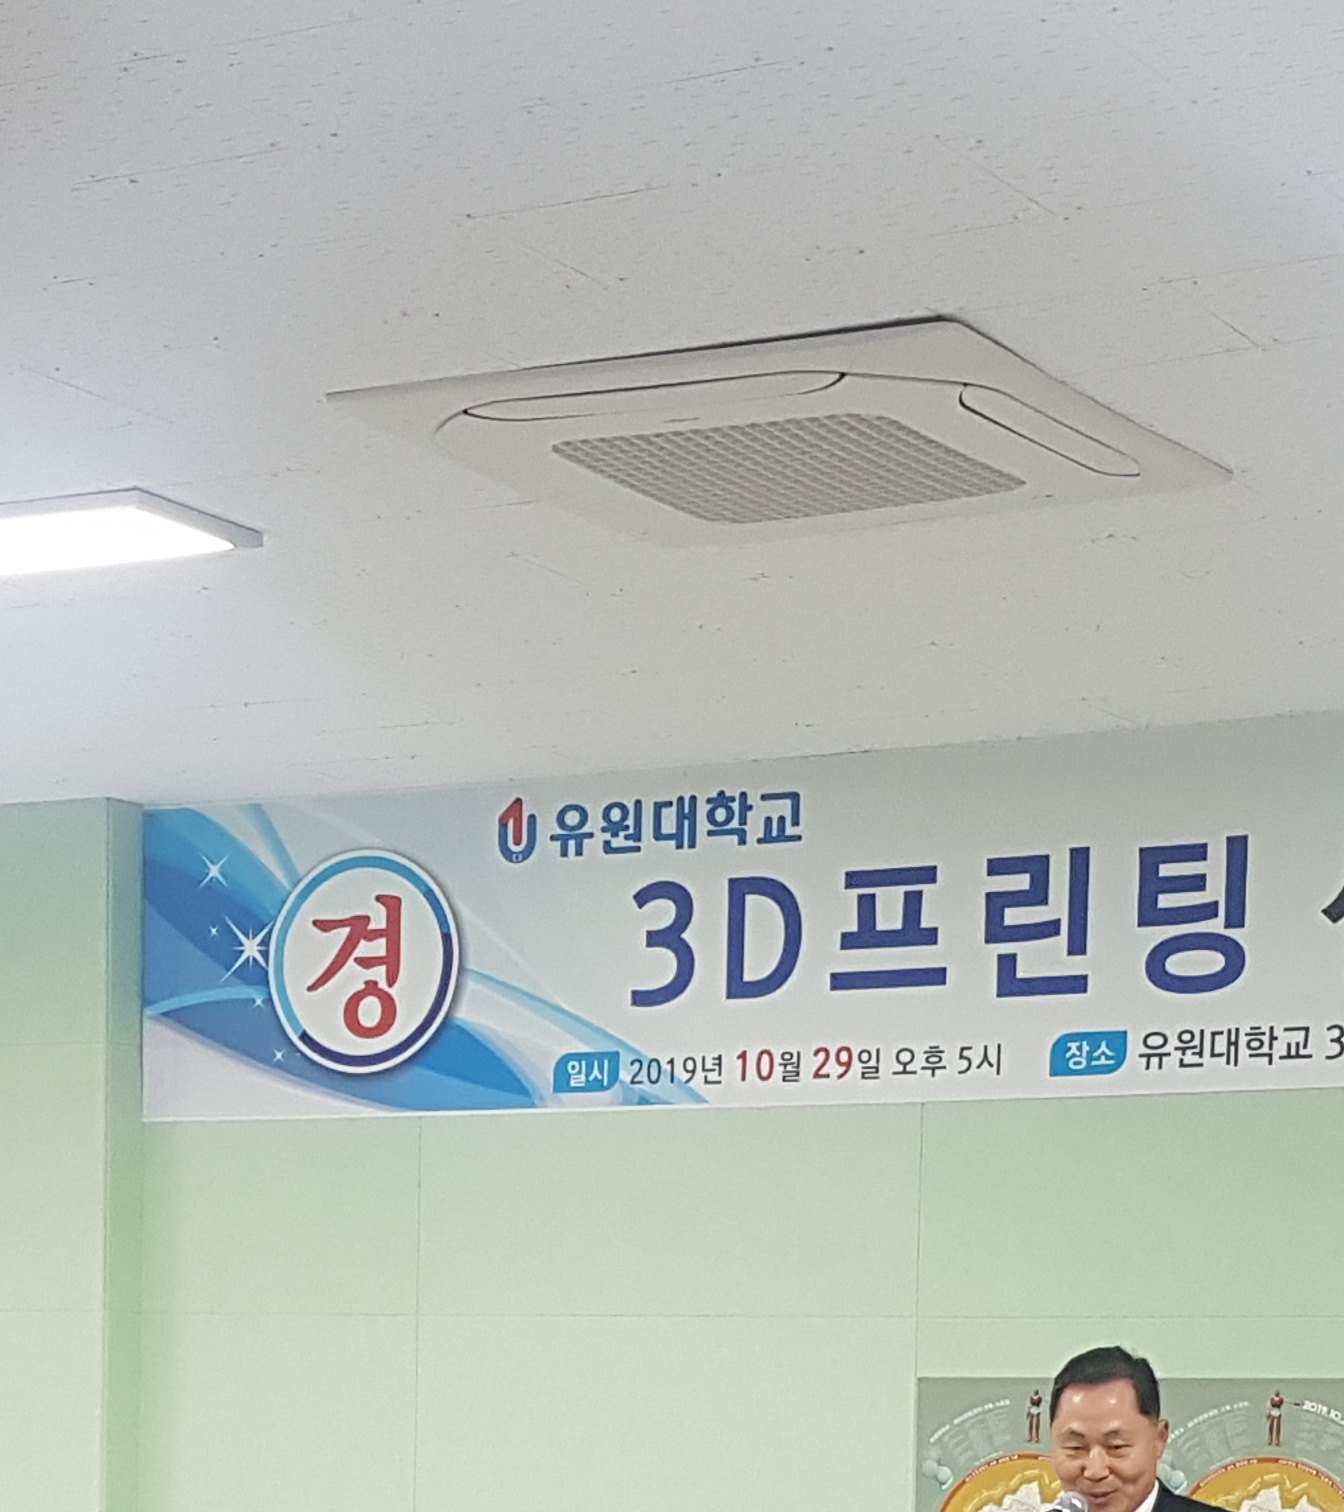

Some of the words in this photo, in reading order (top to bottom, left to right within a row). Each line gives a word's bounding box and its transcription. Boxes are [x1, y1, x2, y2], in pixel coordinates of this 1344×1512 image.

[549, 789, 803, 860] 유원대학교
[630, 834, 1249, 1009] 3D프린팅
[307, 893, 404, 1040] 경
[566, 1058, 609, 1088] 일시
[628, 1053, 724, 1087] 2019년
[735, 1049, 802, 1085] 10월
[811, 1045, 882, 1081] 29일
[891, 1044, 948, 1078] 오후
[958, 1043, 1002, 1077] 5시
[1064, 1039, 1116, 1069] 장소
[1137, 1023, 1313, 1071] 유원대학교
